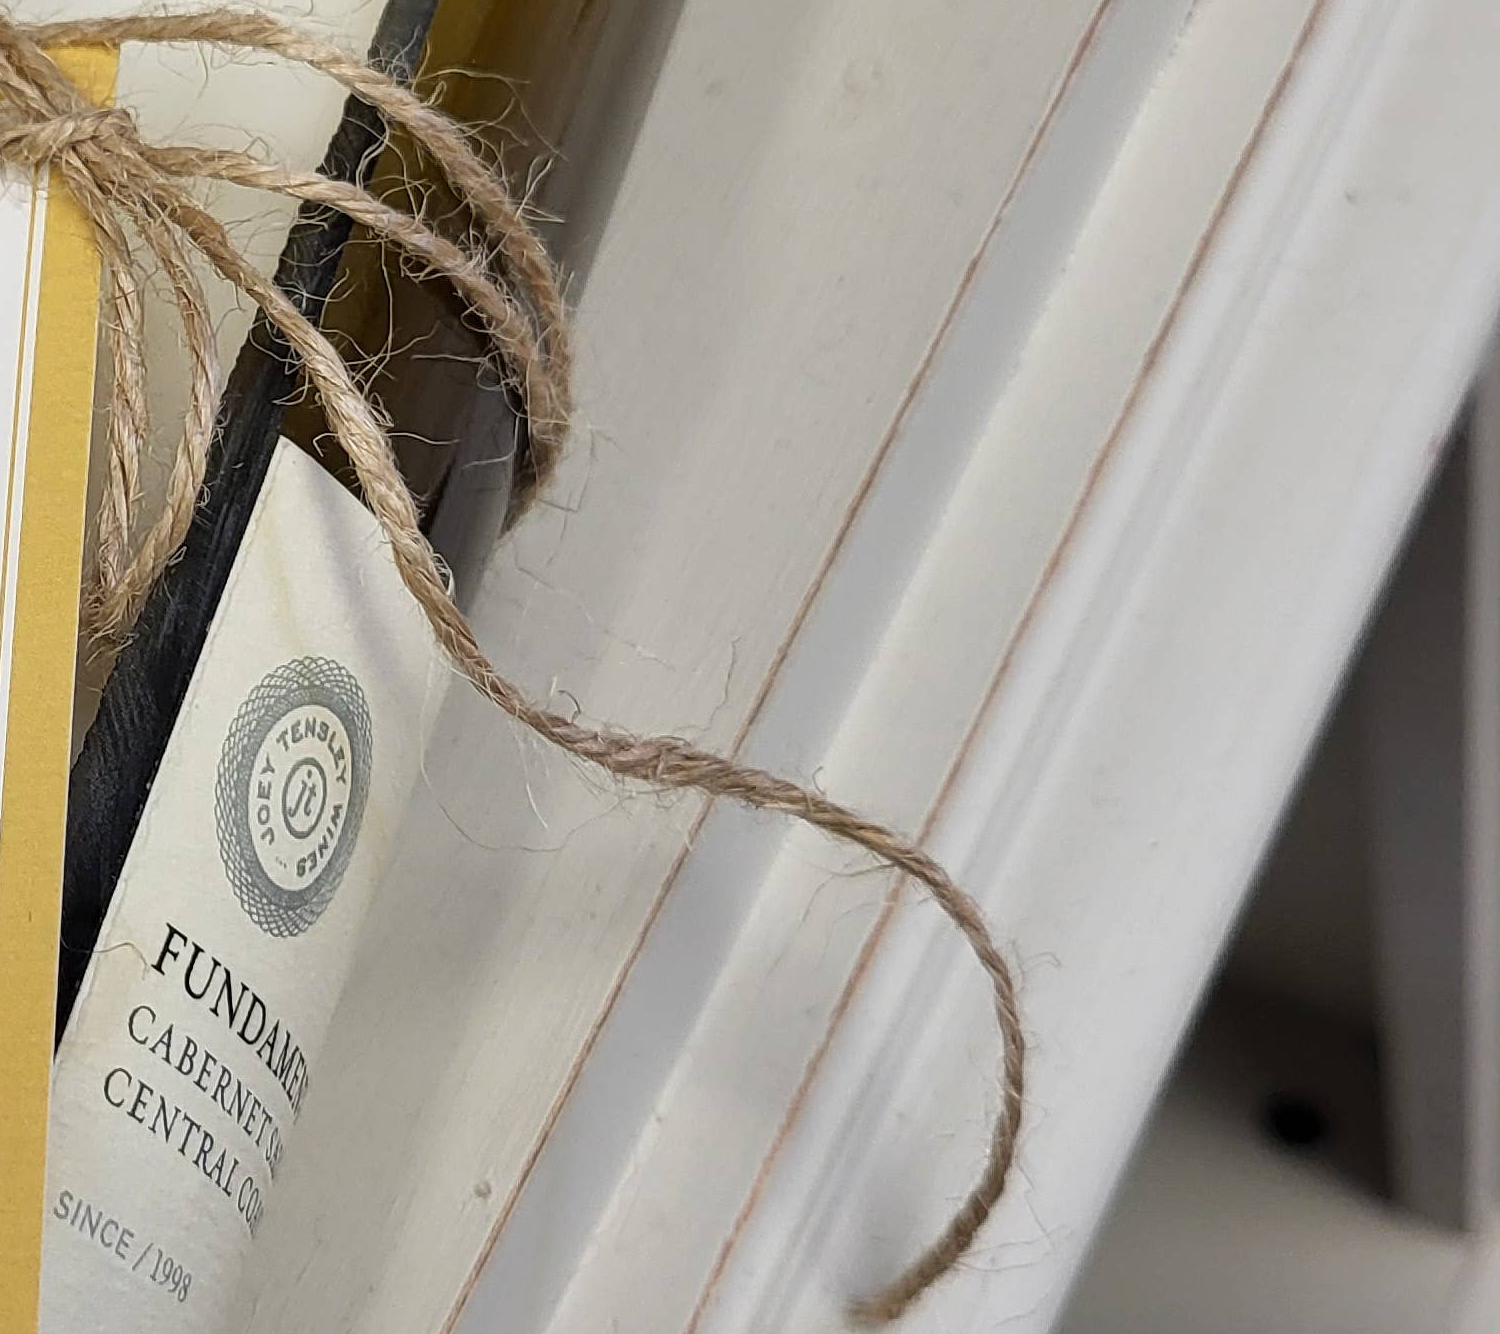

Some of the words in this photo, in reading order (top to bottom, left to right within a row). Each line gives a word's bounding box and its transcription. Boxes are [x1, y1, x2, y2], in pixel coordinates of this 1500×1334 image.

[257, 752, 276, 846] JOEY
[276, 717, 347, 785] TENSLEY
[295, 803, 344, 878] WINES
[128, 1005, 273, 1151] CABERNET
[103, 1067, 243, 1199] CENTRAL
[53, 1190, 135, 1260] SINCE
[149, 1248, 193, 1303] 1998
